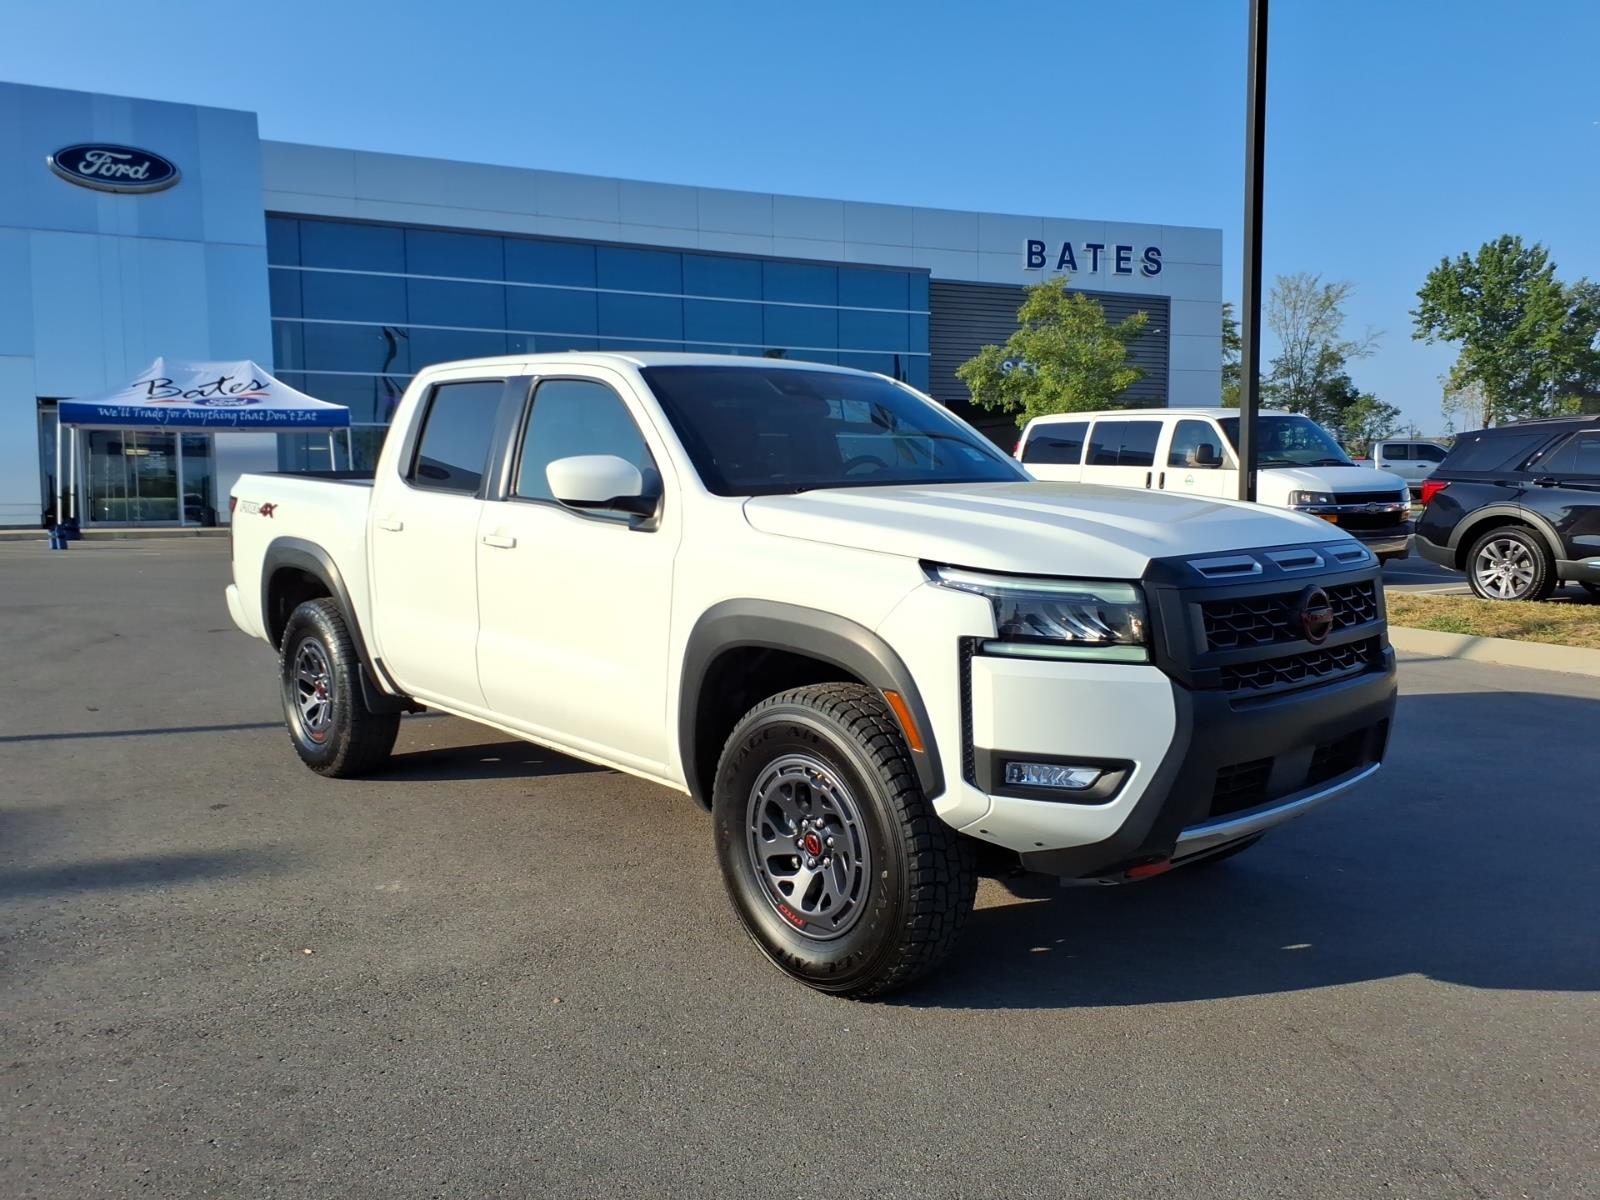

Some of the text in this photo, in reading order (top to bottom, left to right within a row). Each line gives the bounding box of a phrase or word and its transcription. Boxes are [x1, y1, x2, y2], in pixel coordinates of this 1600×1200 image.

[78, 150, 151, 180] Ford
[1024, 239, 1163, 277] BATES
[132, 376, 271, 400] Bates
[98, 407, 318, 425] We'll Trade for Anything that Don't Eat
